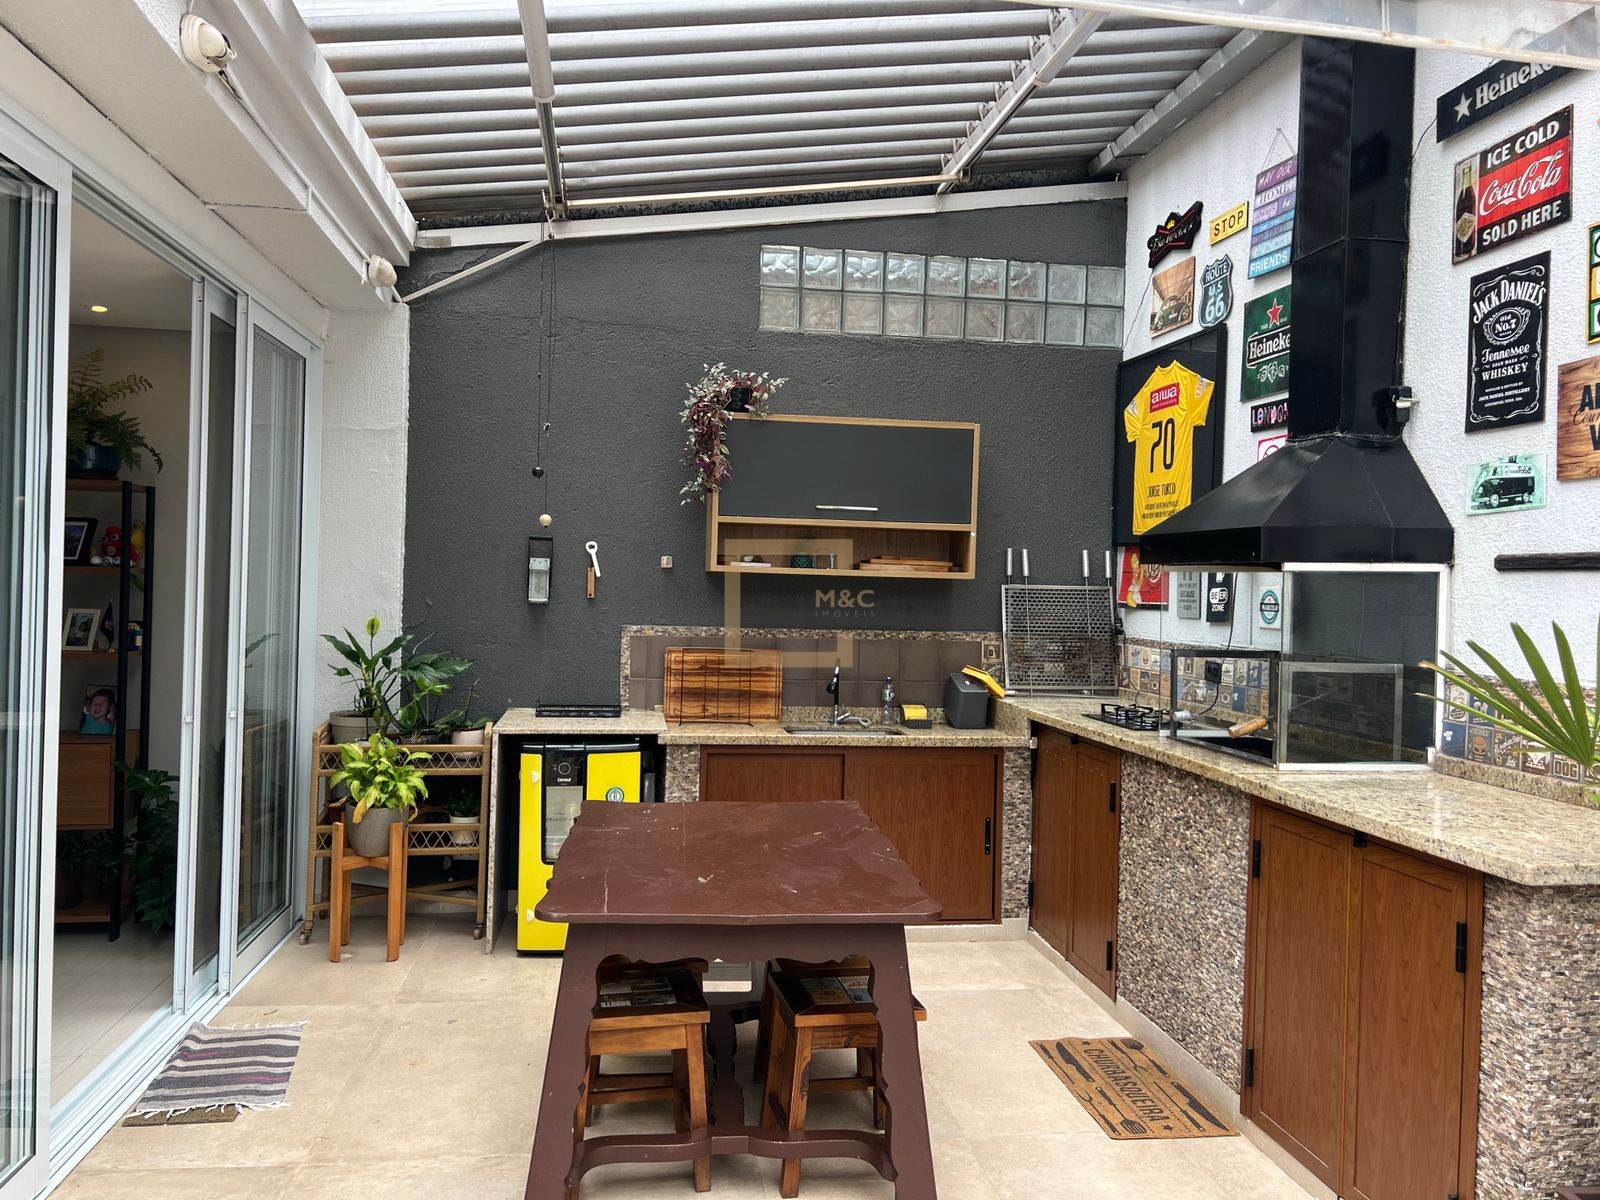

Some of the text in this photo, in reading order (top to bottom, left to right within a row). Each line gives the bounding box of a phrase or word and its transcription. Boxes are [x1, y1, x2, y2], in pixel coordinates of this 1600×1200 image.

[1486, 120, 1560, 169] ICE COLD
[1214, 210, 1244, 236] STOP
[1482, 200, 1561, 246] SOLD HERE
[1205, 262, 1228, 282] ROUTE
[1249, 251, 1288, 276] FRIENDS
[1205, 293, 1224, 321] 66
[1473, 280, 1546, 324] JACK DANIEL'S
[1481, 344, 1530, 363] Tennessee
[1482, 362, 1529, 381] WHISKEY
[1152, 386, 1177, 404] aiwa
[1150, 418, 1175, 473] 70
[1554, 760, 1579, 780] DOG
[1083, 1048, 1168, 1122] CHURRASQUEIRA
